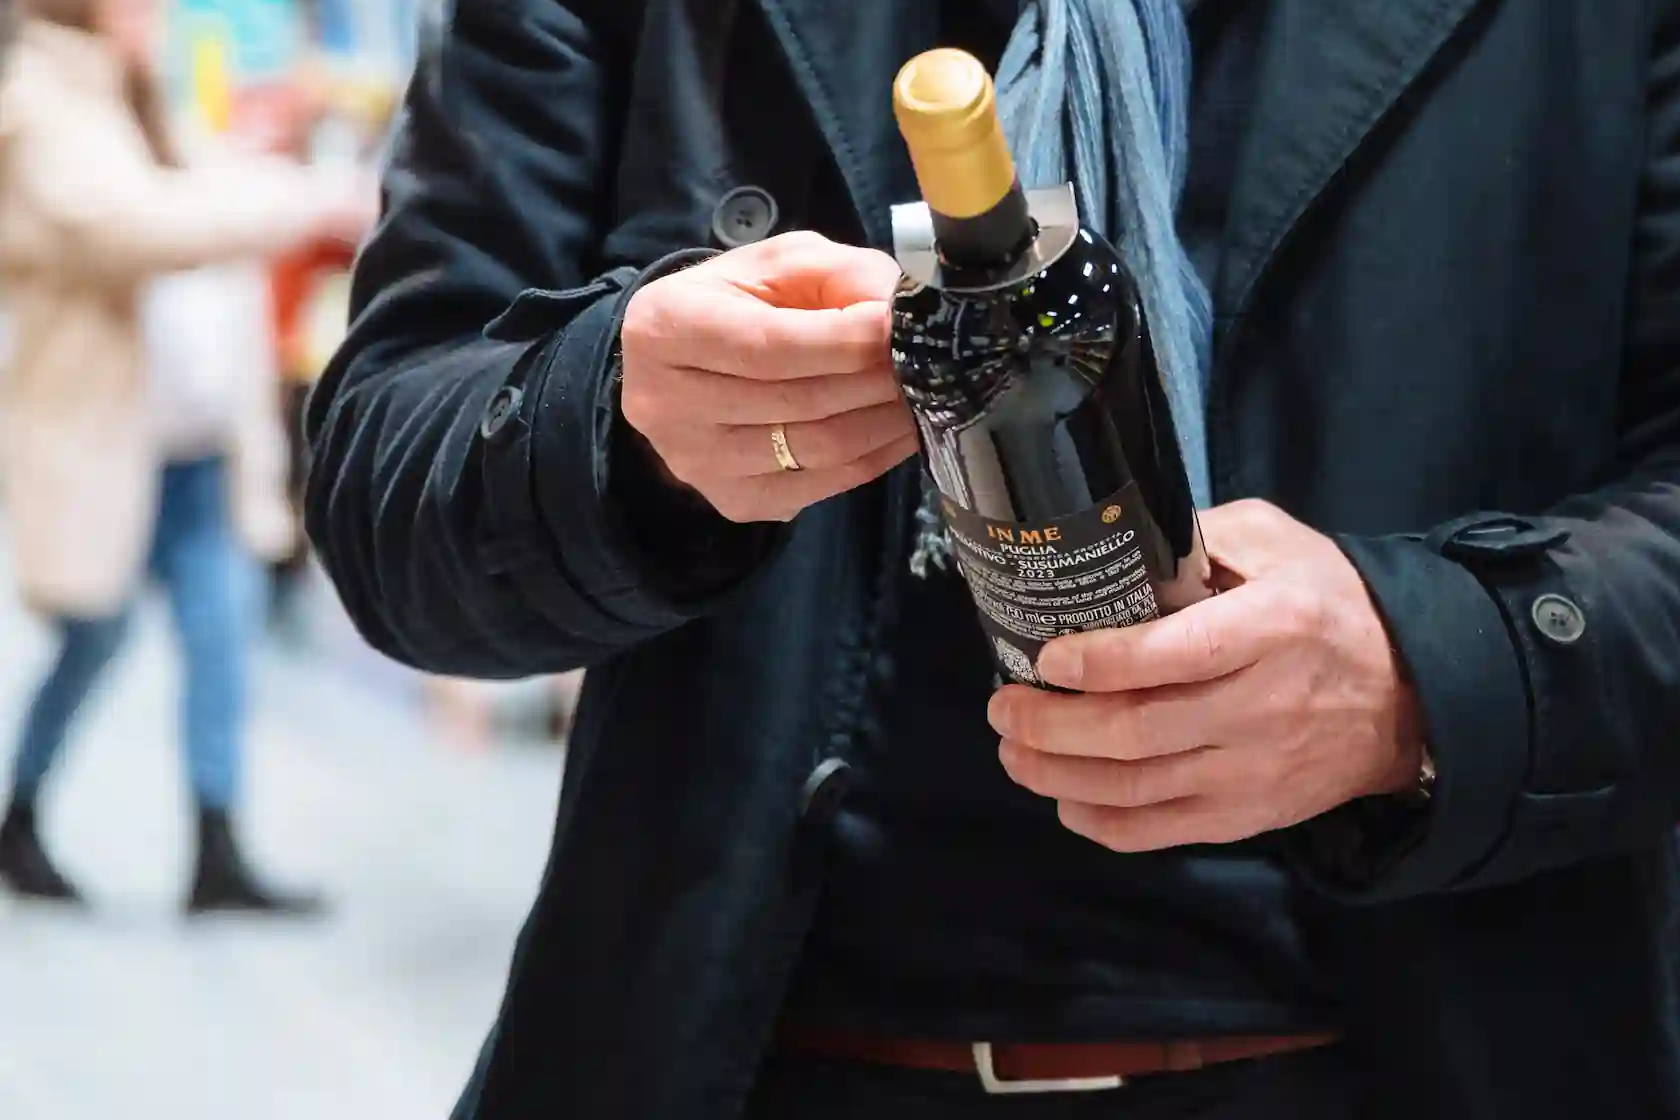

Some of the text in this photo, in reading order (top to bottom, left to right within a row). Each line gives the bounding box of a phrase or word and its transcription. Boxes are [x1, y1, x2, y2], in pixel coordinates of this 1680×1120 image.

[986, 523, 1062, 545] IN ME
[1000, 543, 1058, 556] PUGLIA
[1018, 529, 1135, 570] SUSUMANIELLO
[1017, 569, 1055, 579] 2023
[1006, 605, 1025, 621] 750
[1058, 604, 1112, 625] PRODOTTO
[1113, 599, 1125, 613] IN
[1126, 583, 1153, 607] ITALIA
